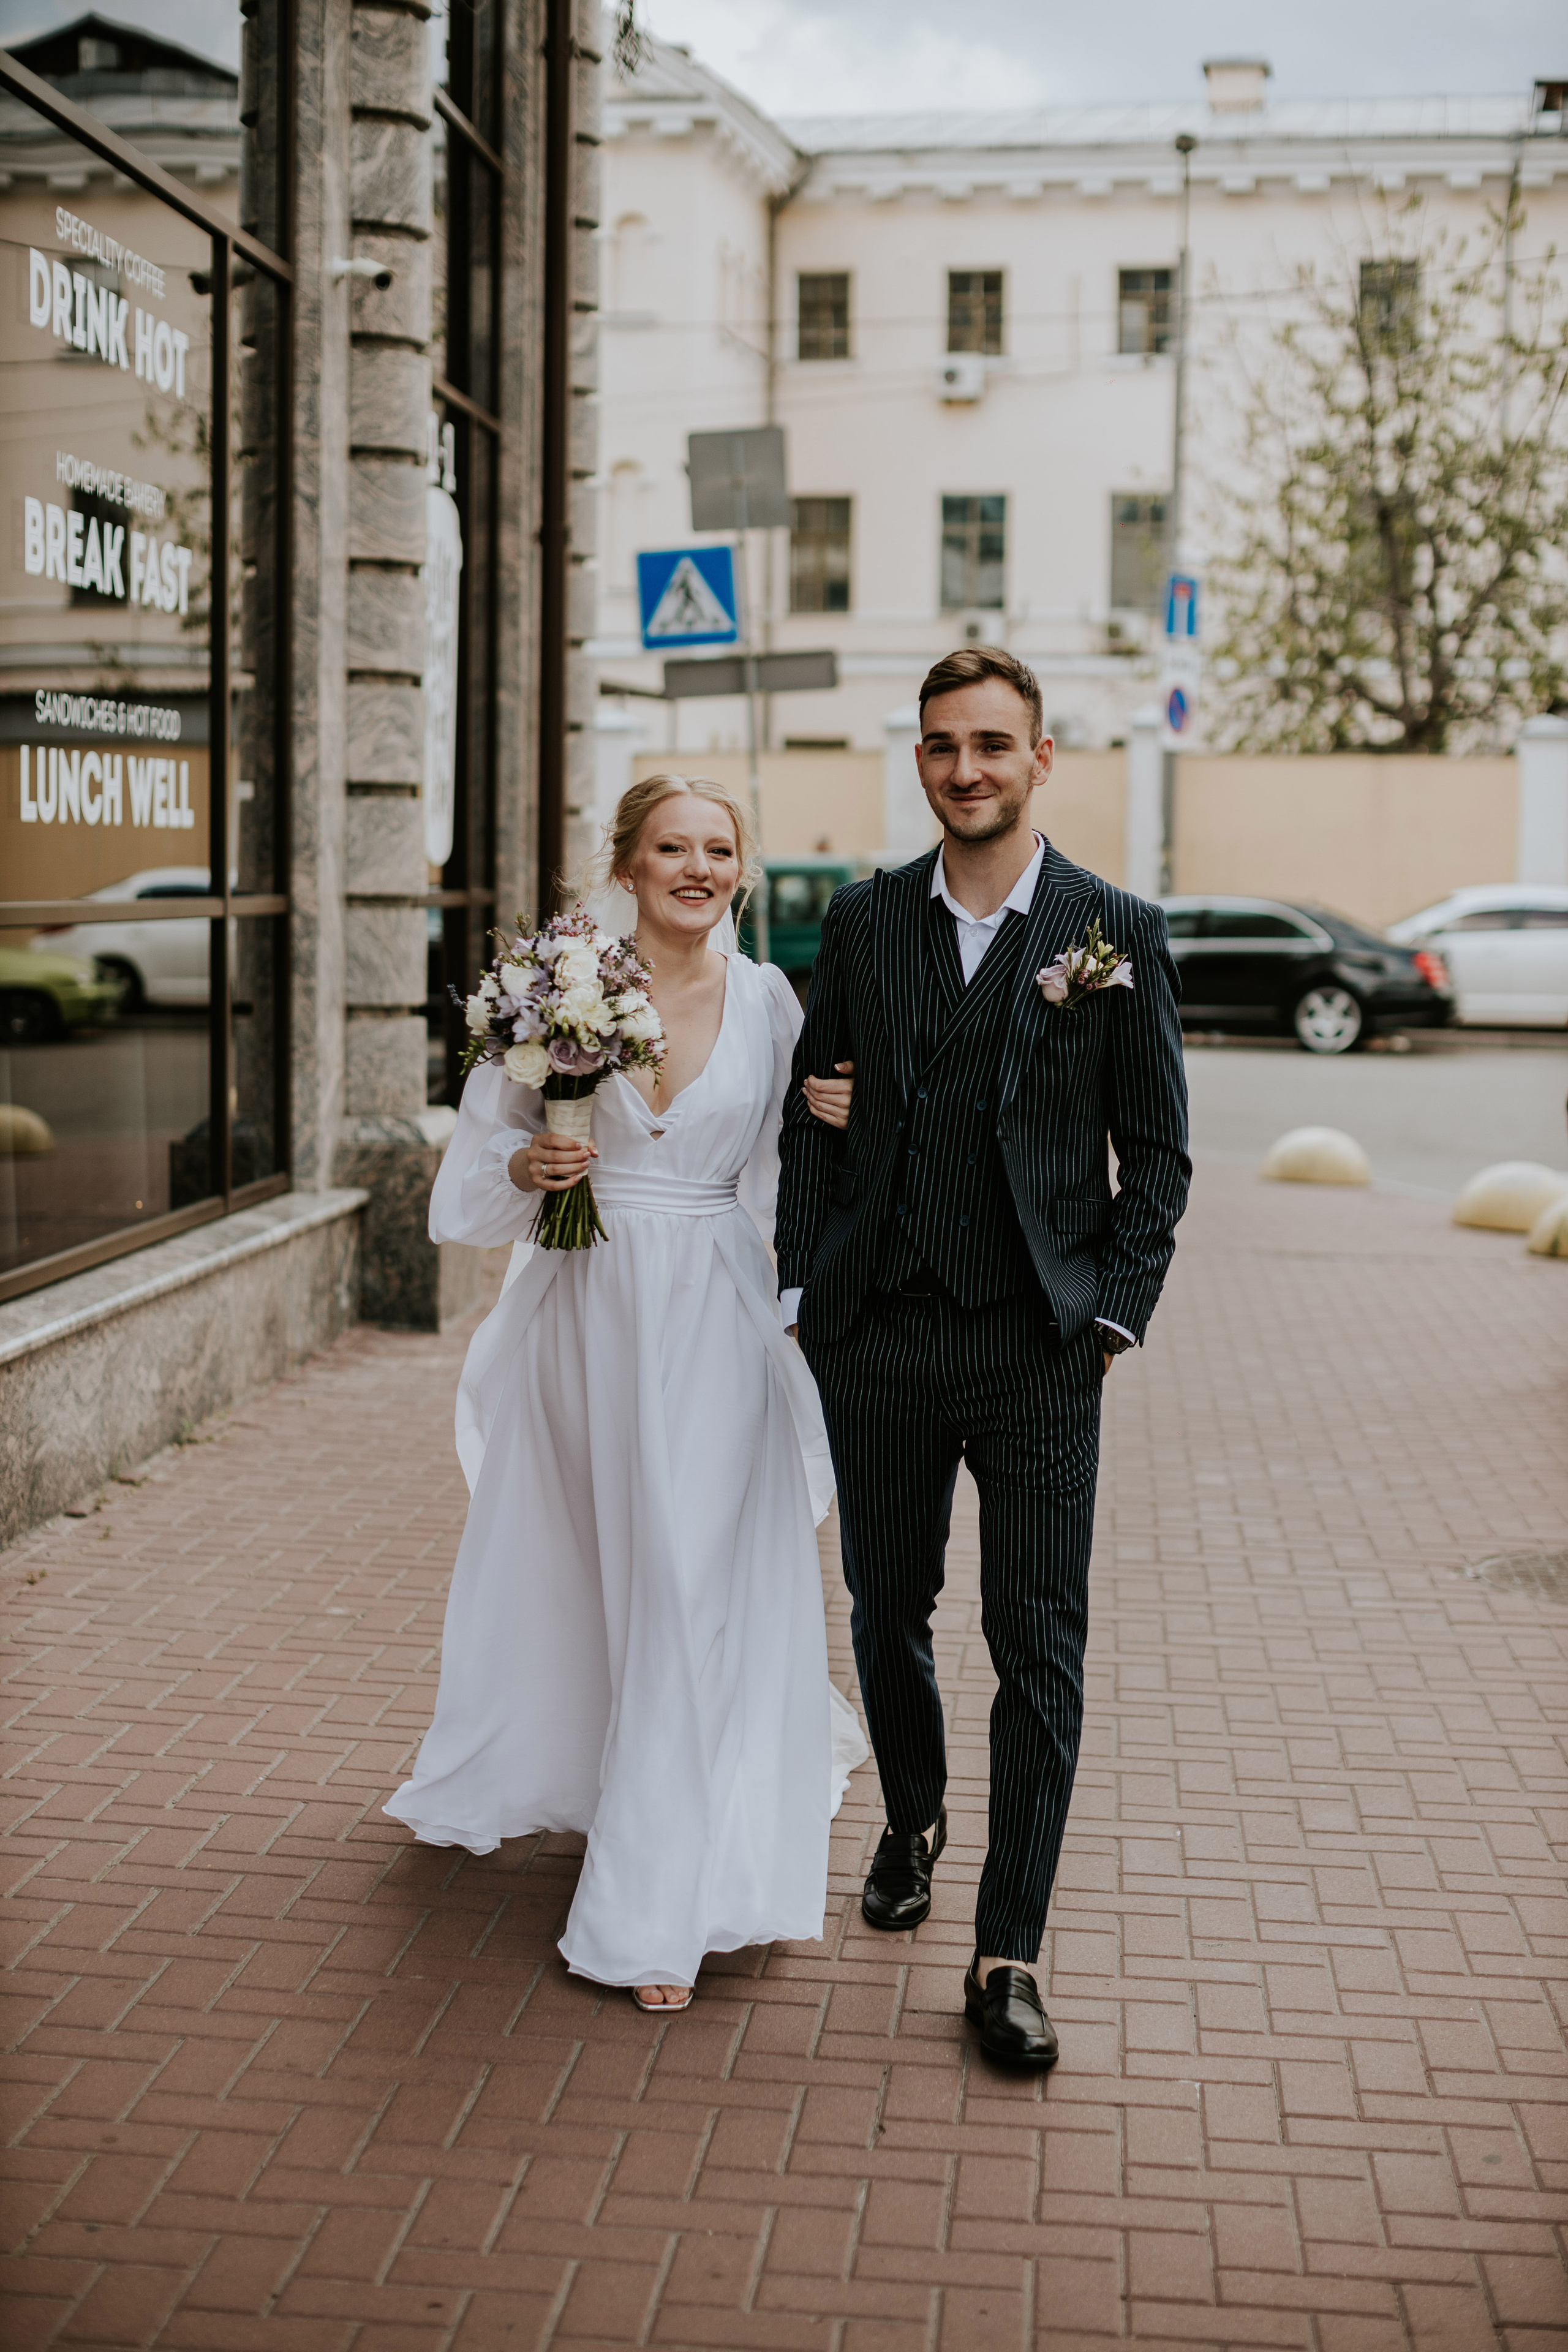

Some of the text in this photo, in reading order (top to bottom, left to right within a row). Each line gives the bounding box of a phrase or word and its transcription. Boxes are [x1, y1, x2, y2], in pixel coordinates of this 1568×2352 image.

[124, 249, 166, 301] COFFEE
[29, 246, 189, 400] DRINK HOT
[56, 450, 167, 519] HOMEMADE BAKERY
[24, 496, 192, 616] BREAK FAST
[35, 689, 117, 734] SANDWICHES
[126, 704, 150, 737] HOT
[149, 707, 181, 741] FOOD
[20, 744, 195, 829] LUNCH WELL
